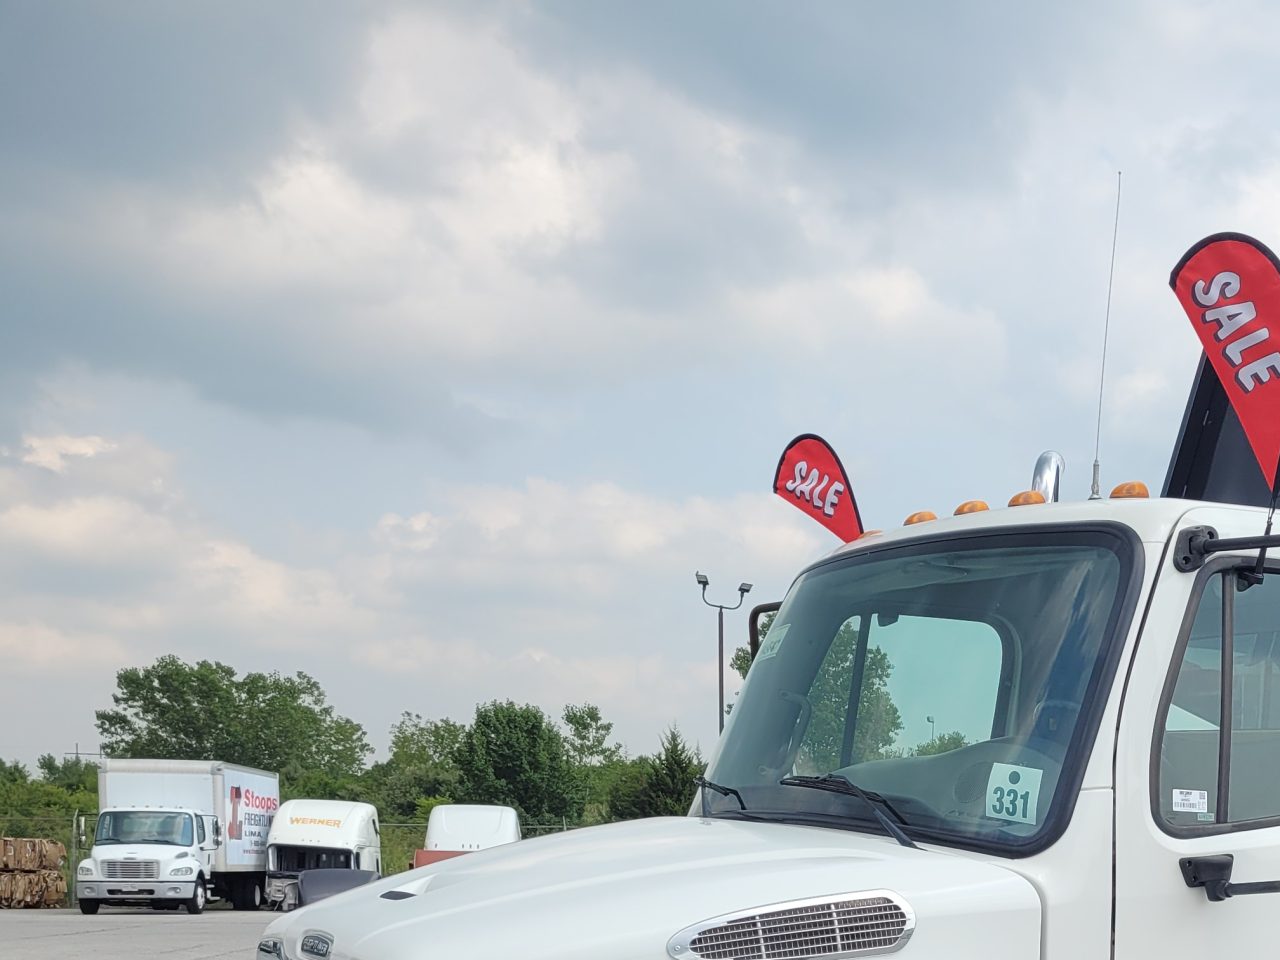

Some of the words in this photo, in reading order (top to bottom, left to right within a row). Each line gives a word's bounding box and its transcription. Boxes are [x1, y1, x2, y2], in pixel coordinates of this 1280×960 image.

[786, 461, 845, 517] SALE
[244, 789, 278, 812] Stoops
[992, 786, 1030, 819] 331
[290, 816, 342, 828] WERNER
